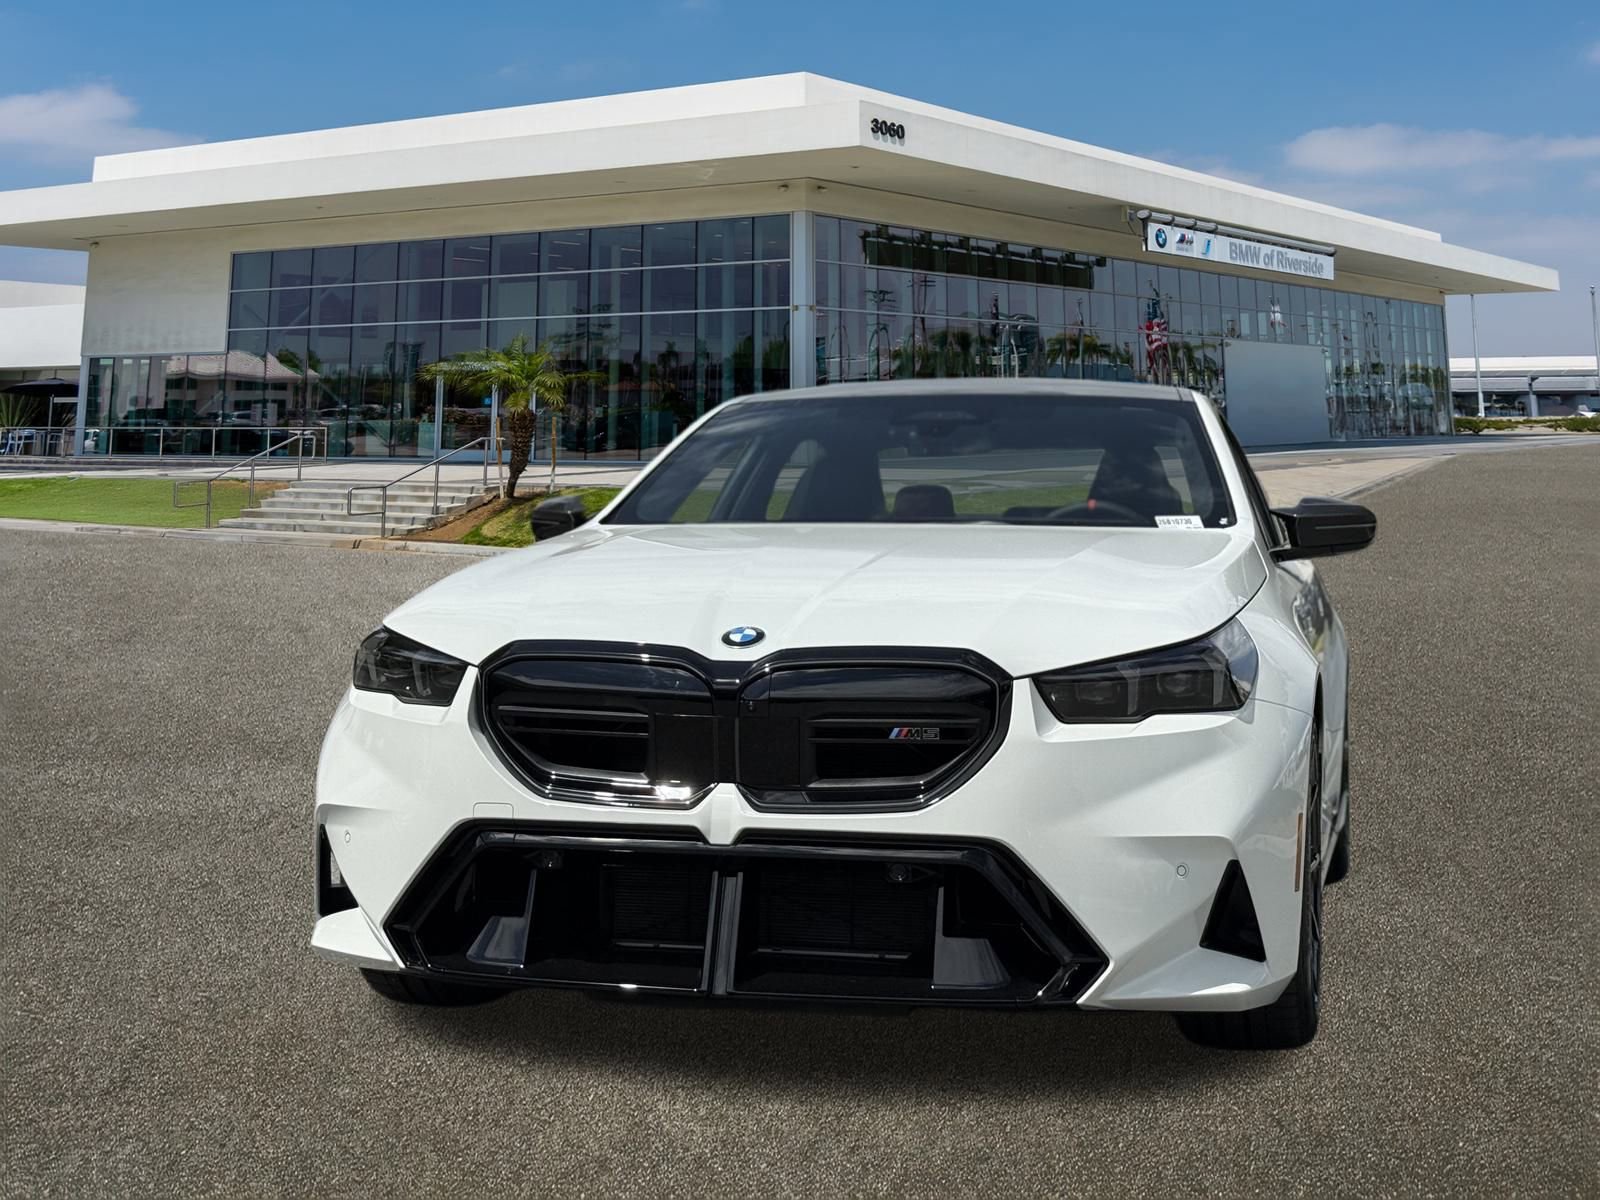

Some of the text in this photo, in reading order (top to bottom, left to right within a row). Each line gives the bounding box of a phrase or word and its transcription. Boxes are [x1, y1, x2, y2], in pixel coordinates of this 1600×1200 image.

[870, 117, 905, 140] 3060
[1229, 242, 1324, 275] BMW of Riverside
[889, 727, 940, 740] M5
